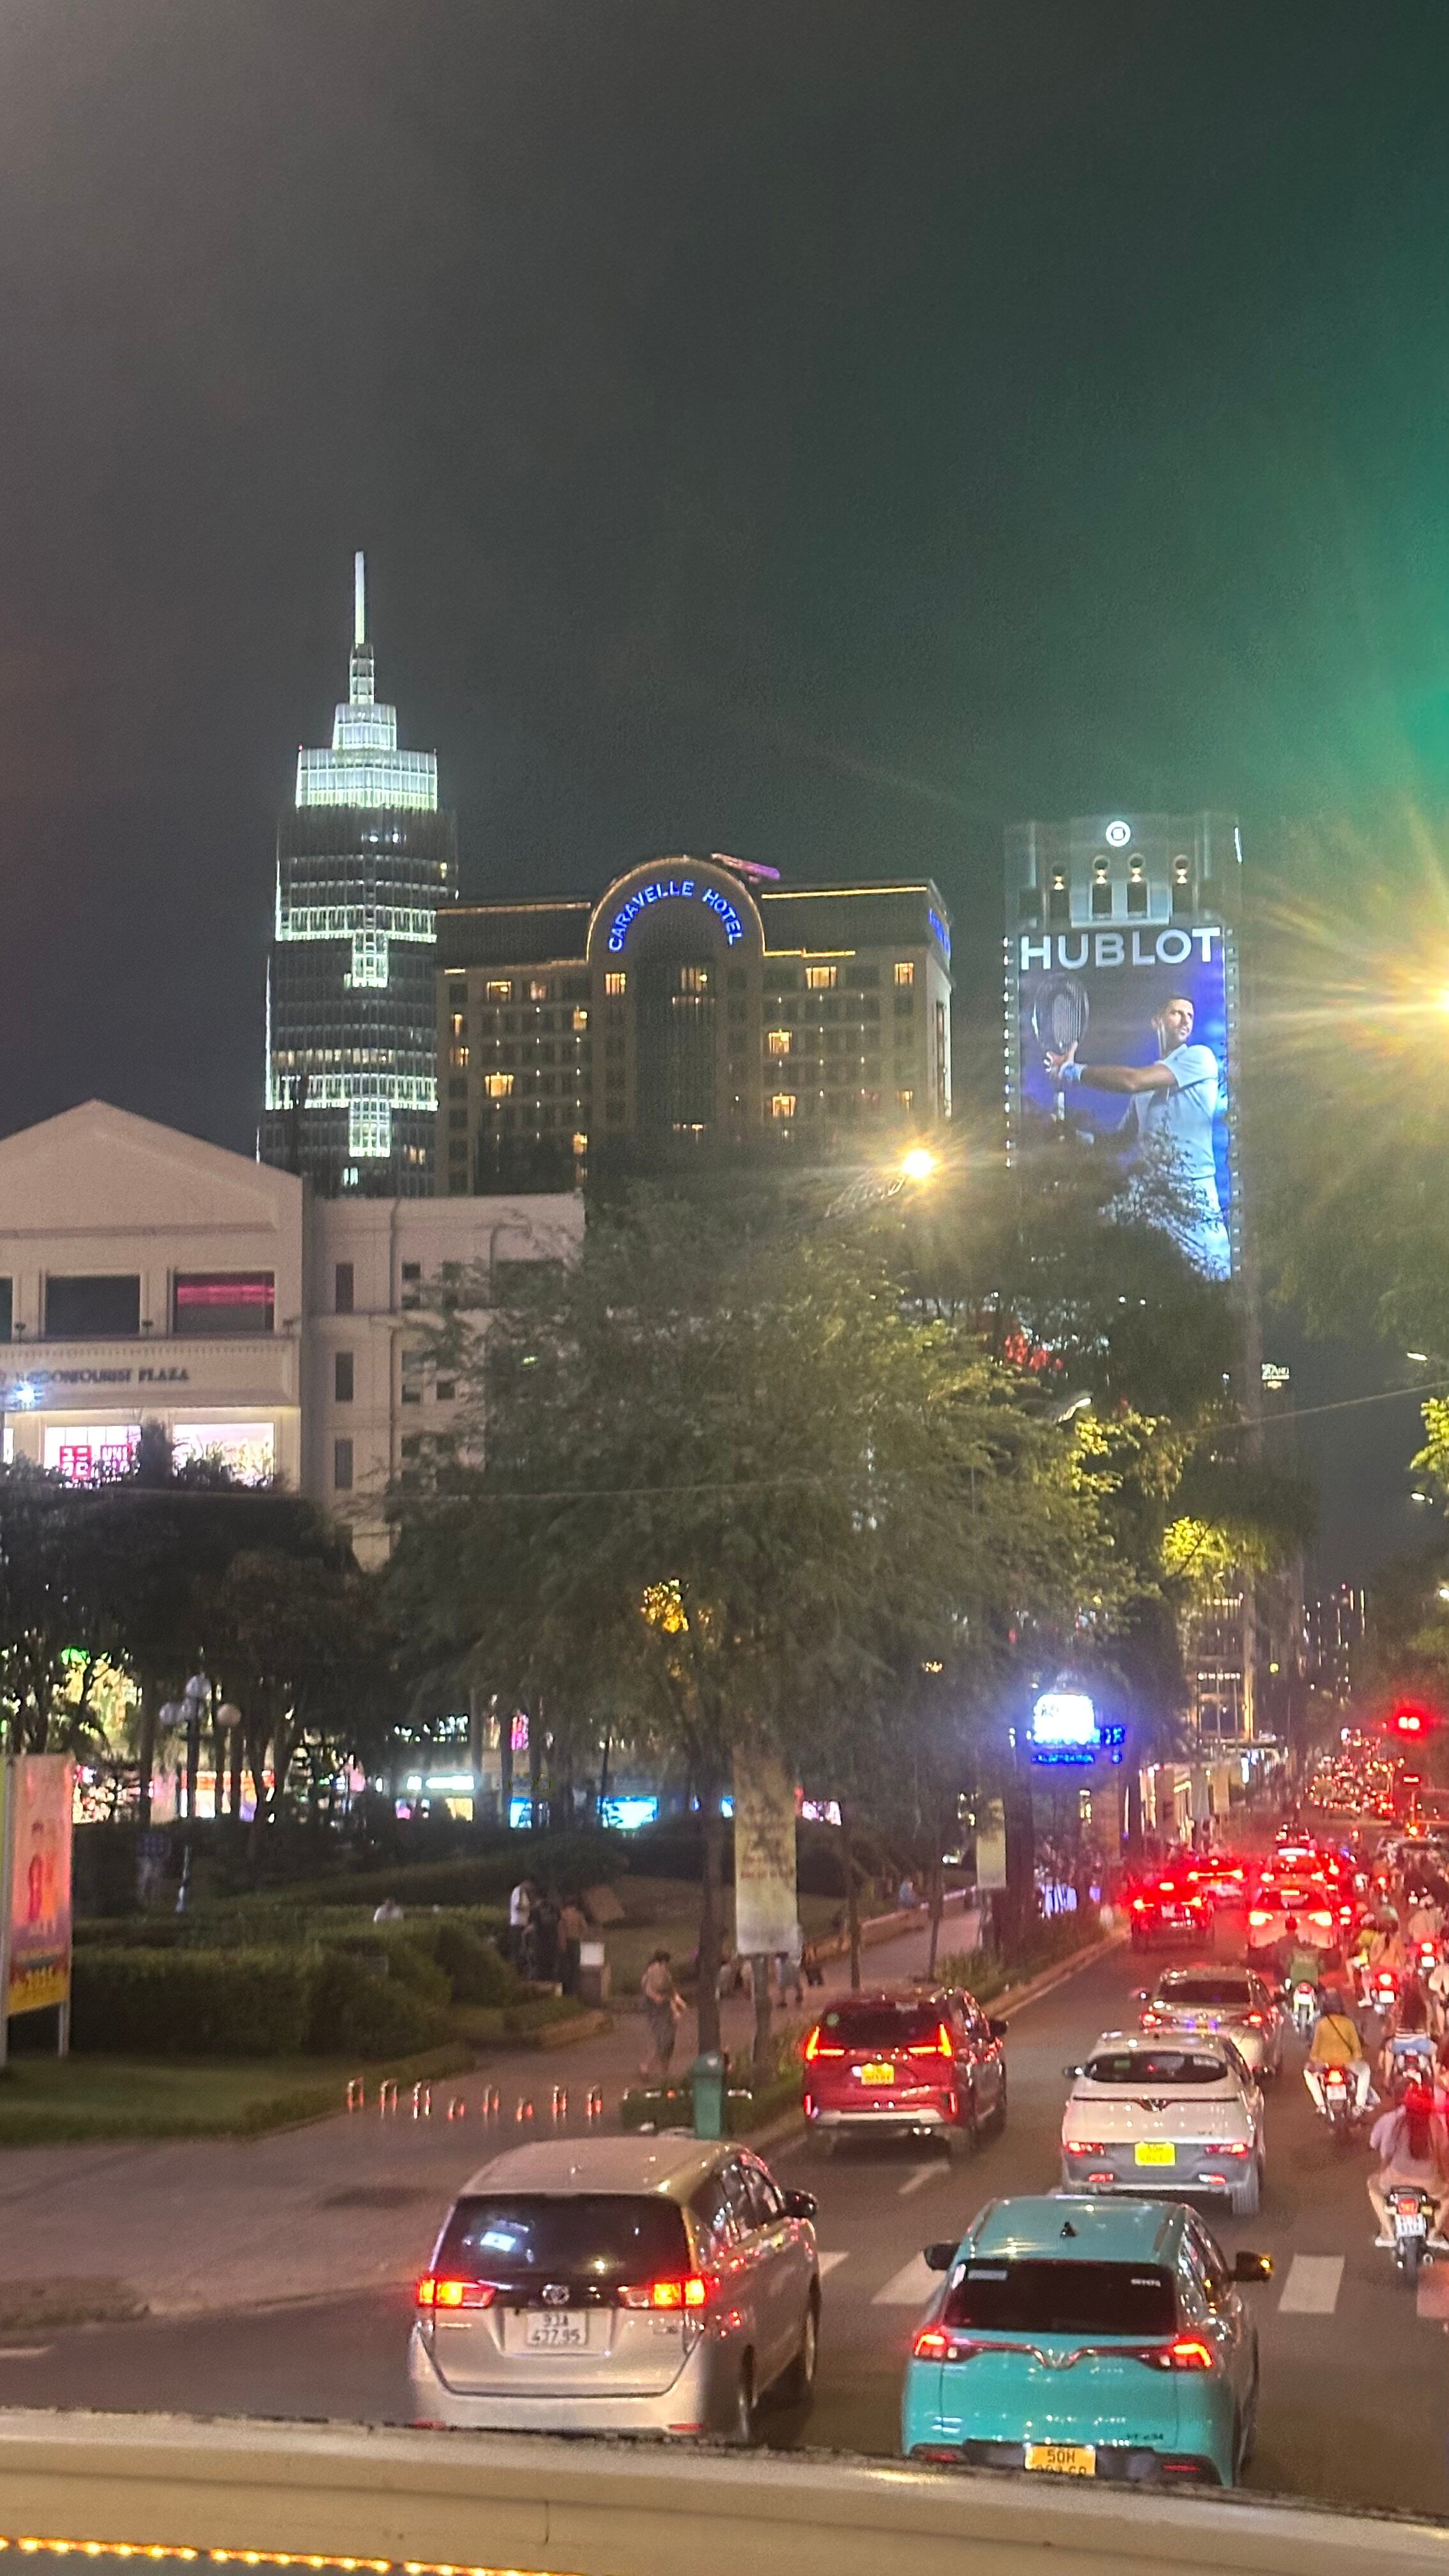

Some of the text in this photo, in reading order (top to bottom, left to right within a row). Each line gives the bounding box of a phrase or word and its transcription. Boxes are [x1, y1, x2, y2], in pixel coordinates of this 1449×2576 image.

[609, 880, 742, 952] CARAVELLE HOTEL
[1021, 927, 1220, 970] HUBLOT
[138, 1367, 189, 1382] PLAZA
[1047, 2448, 1075, 2464] 50H
